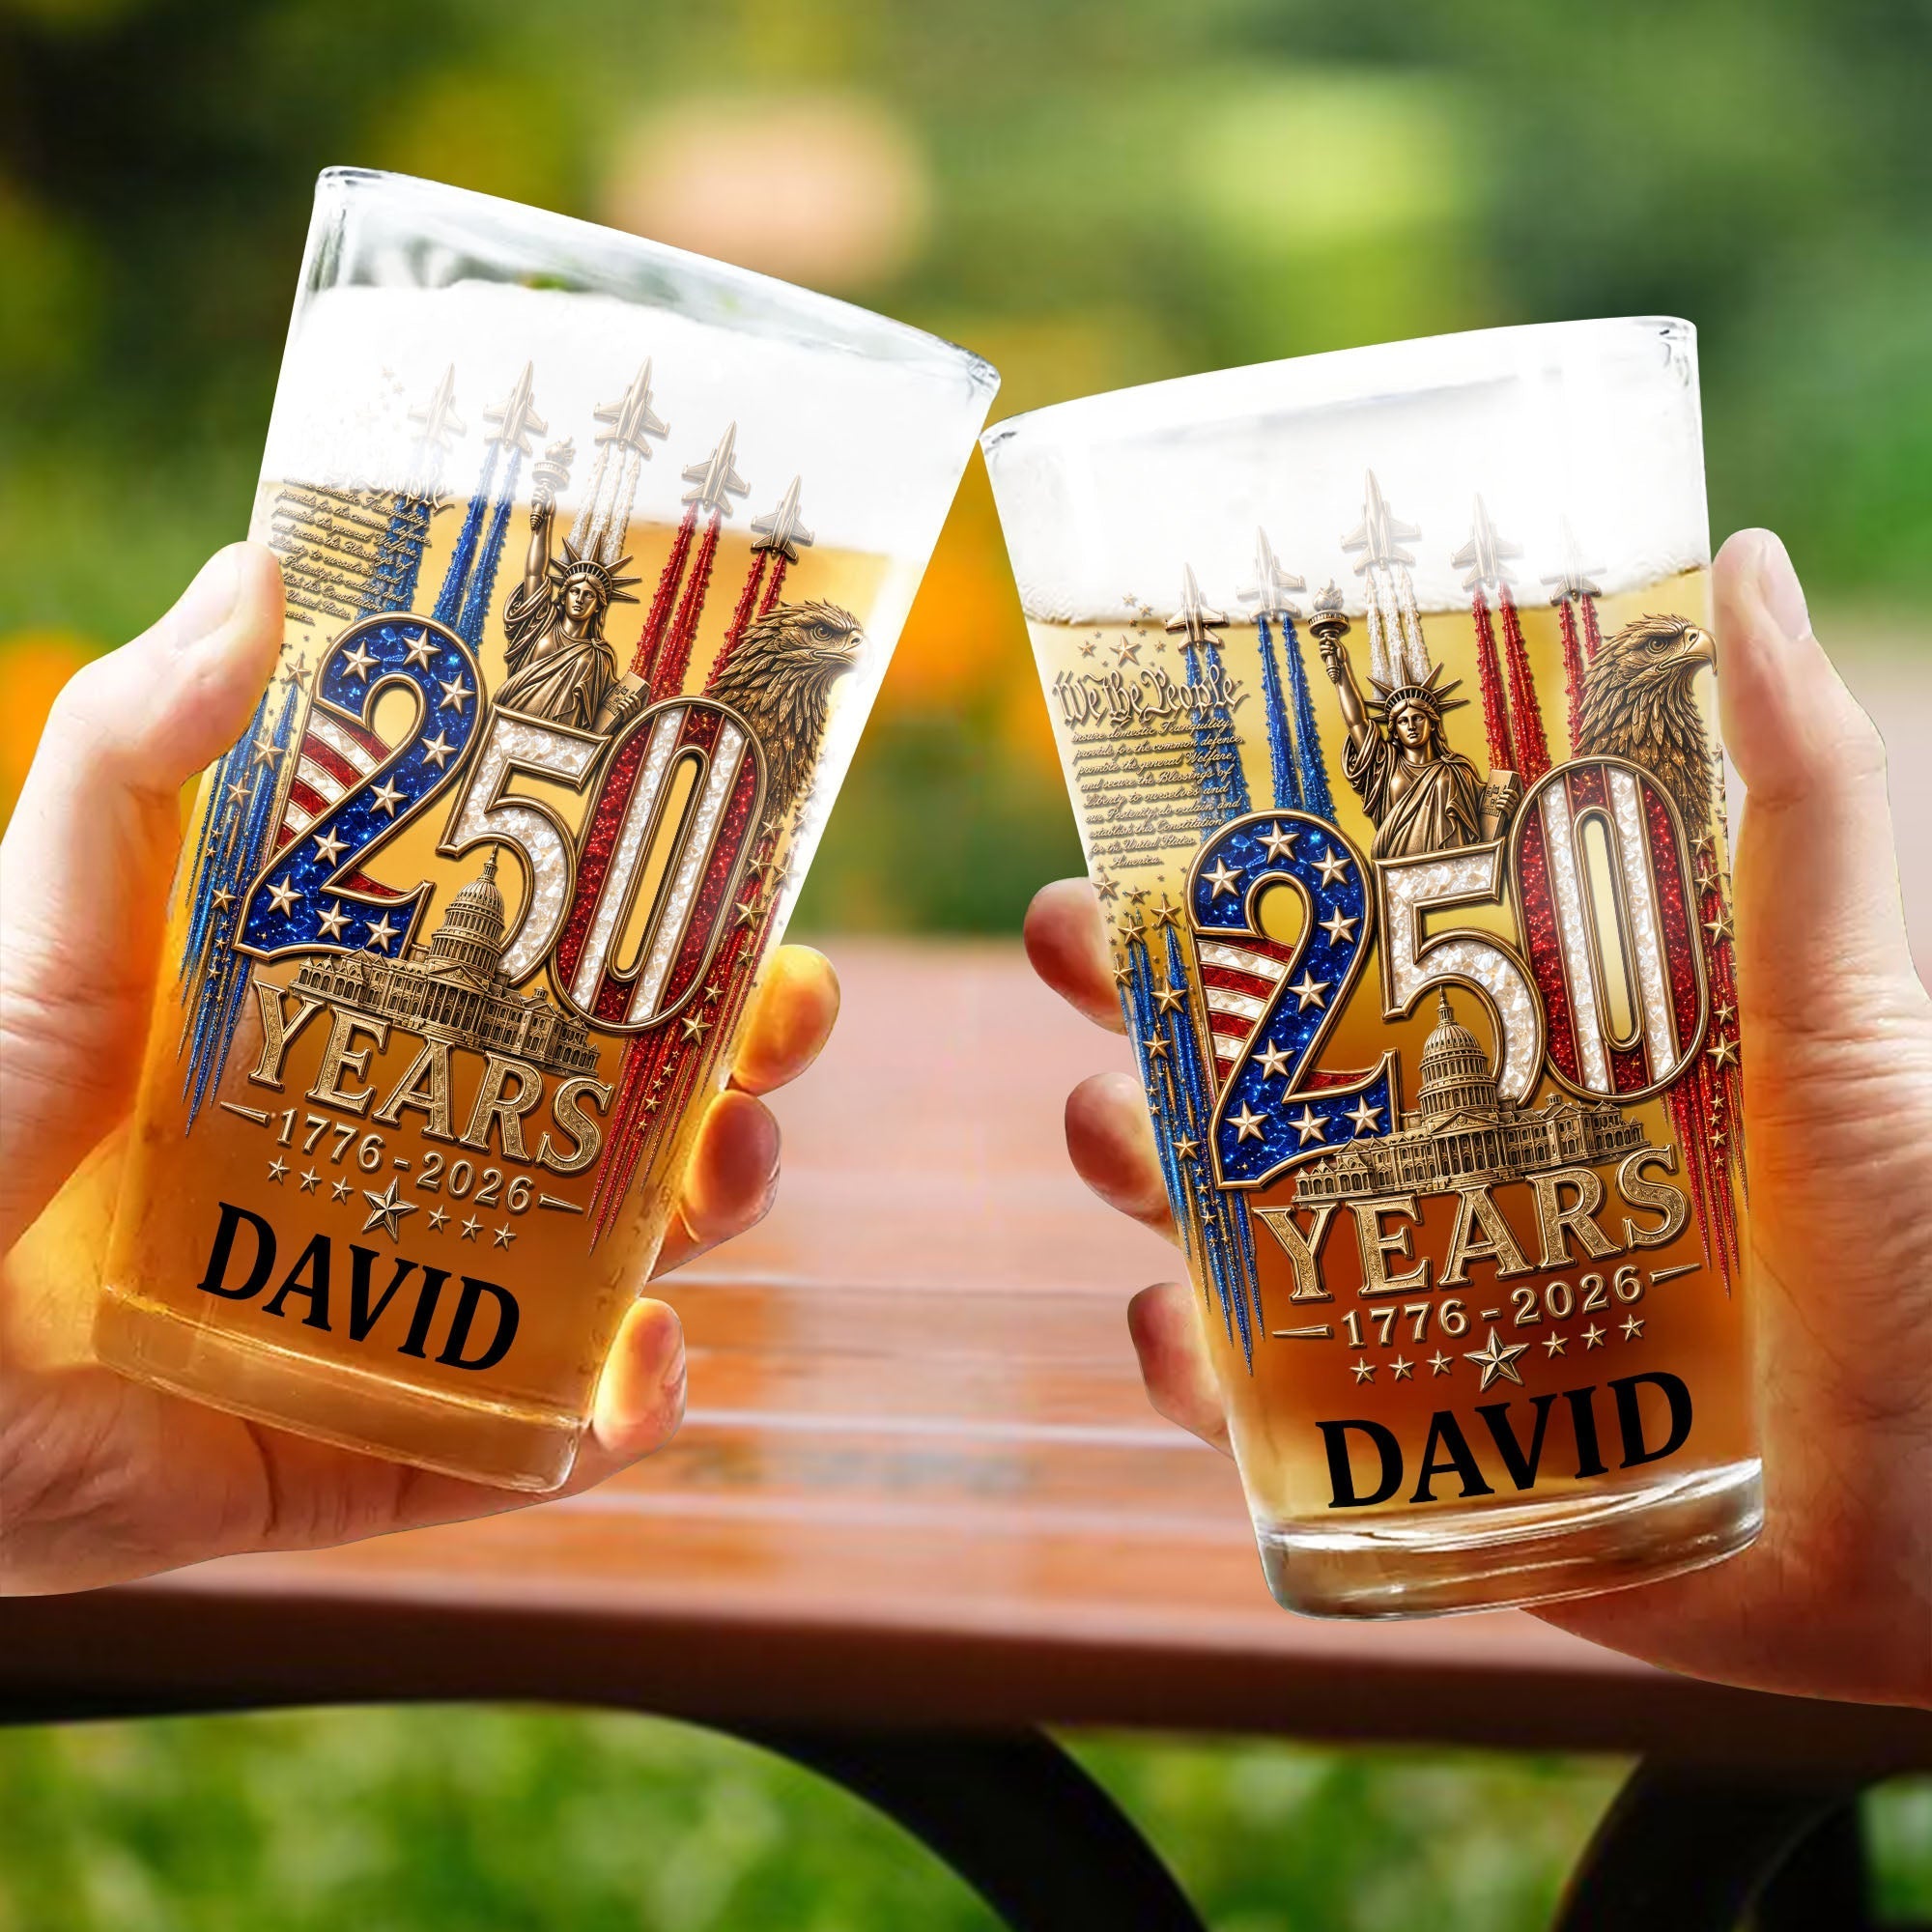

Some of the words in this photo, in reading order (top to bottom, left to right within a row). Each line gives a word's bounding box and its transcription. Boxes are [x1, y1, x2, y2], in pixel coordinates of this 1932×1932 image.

[310, 499, 332, 516] for
[333, 505, 351, 519] the
[349, 514, 391, 531] common
[316, 517, 332, 530] the
[309, 549, 323, 560] to
[376, 573, 404, 585] and
[323, 535, 341, 549] the
[341, 541, 394, 566] Blessings
[395, 560, 414, 575] of
[329, 572, 344, 583] do
[383, 590, 411, 603] and
[1053, 670, 1108, 726] We
[1086, 669, 1144, 724] the
[1139, 664, 1250, 724] People
[1107, 725, 1156, 740] domestic
[1112, 743, 1132, 760] for
[1134, 740, 1151, 753] the
[1152, 741, 1198, 752] common
[1122, 757, 1138, 770] the
[1136, 753, 1183, 776] general
[1185, 750, 1236, 767] Welfare,
[1081, 779, 1103, 790] and
[1103, 779, 1135, 789] secure
[1138, 772, 1154, 784] the
[1156, 769, 1214, 784] Blessings
[1217, 763, 1236, 782] of
[1128, 792, 1142, 803] to
[1144, 786, 1200, 802] ourselves
[1203, 781, 1231, 795] and
[1158, 803, 1172, 816] do
[1175, 800, 1214, 813] ordain
[1217, 794, 1243, 810] and
[233, 612, 767, 1034] 250
[1135, 820, 1155, 834] this
[1157, 816, 1225, 833] Constitution
[1122, 837, 1160, 851] United
[1184, 755, 1709, 1189] 250
[248, 979, 615, 1175] YEARS
[1252, 1143, 1690, 1303] YEARS
[196, 1201, 520, 1371] DAVID
[1315, 1372, 1693, 1509] DAVID
